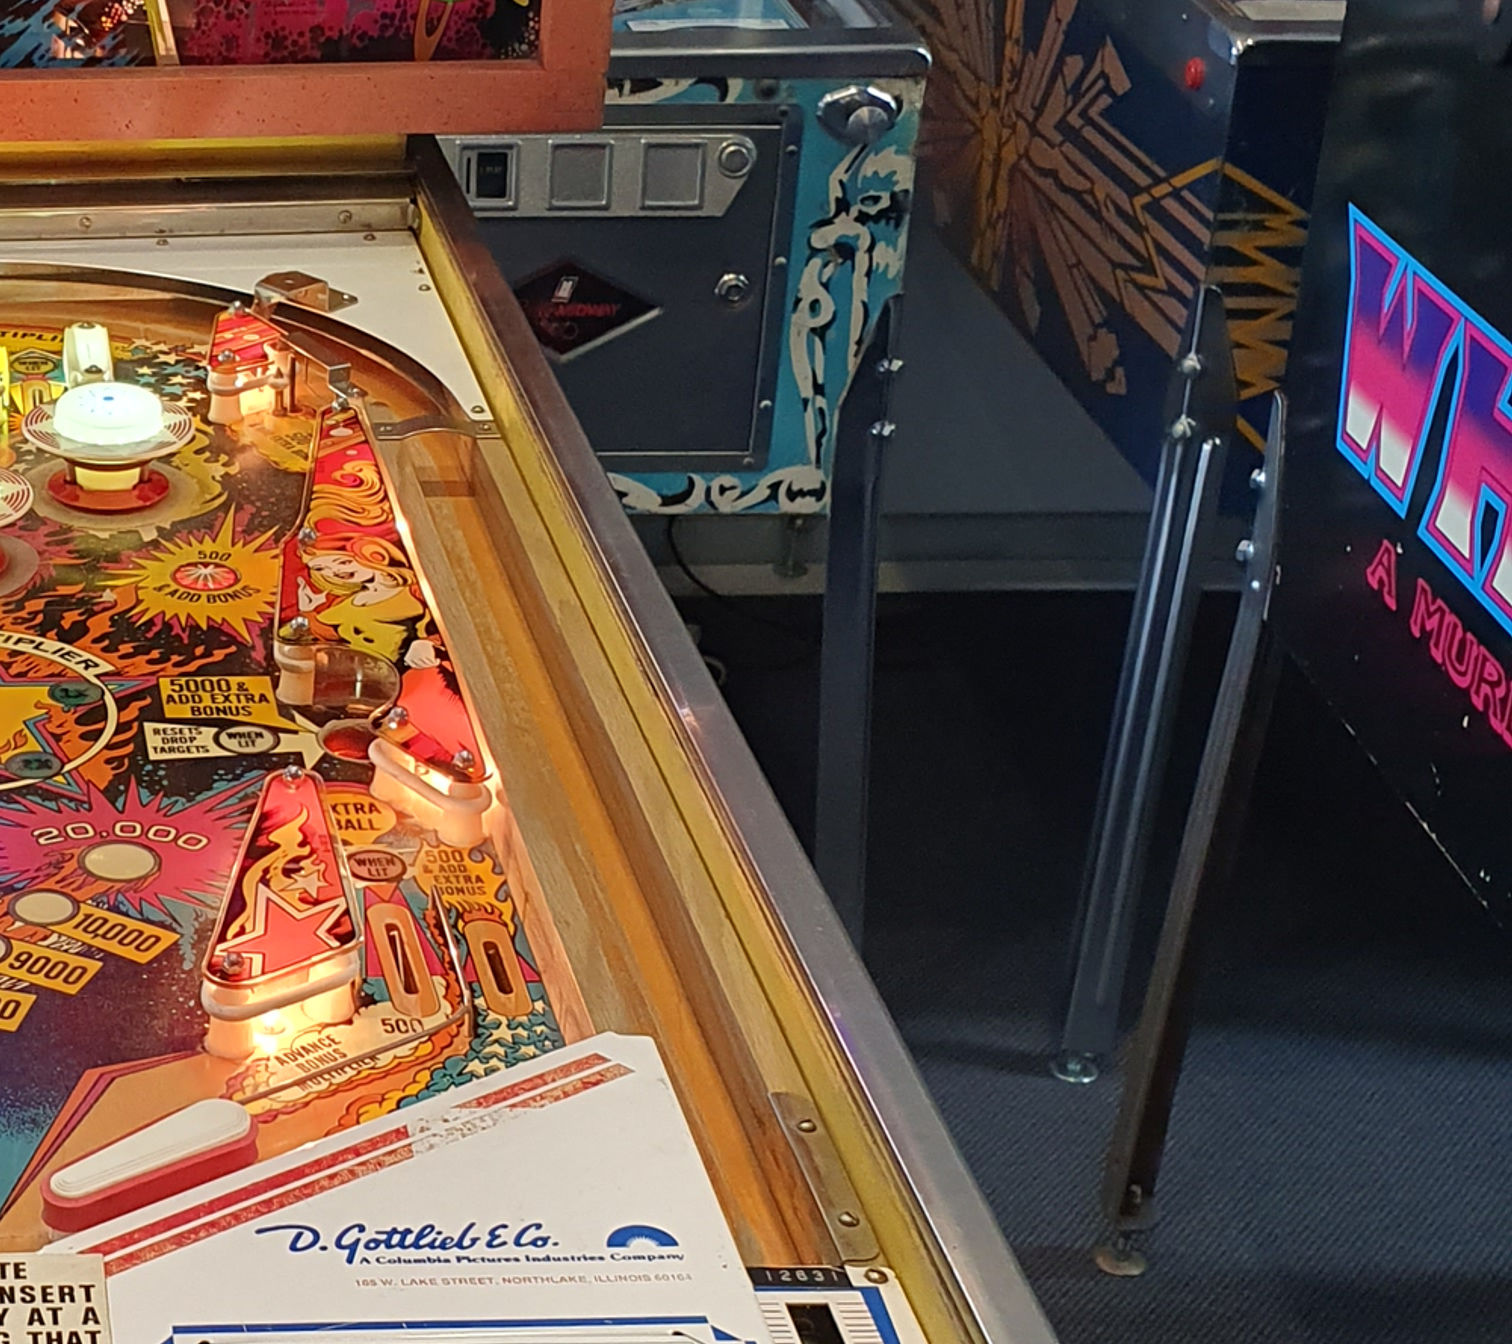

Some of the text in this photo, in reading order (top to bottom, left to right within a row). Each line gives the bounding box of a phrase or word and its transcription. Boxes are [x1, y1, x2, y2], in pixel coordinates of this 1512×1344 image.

[198, 550, 232, 562] 500
[1366, 539, 1396, 611] A
[170, 678, 249, 693] 5000 &
[165, 693, 271, 705] ADD EXTRA
[190, 705, 253, 717] BONUS
[152, 726, 203, 736] RESETS
[225, 730, 265, 740] WHEN
[161, 736, 197, 745] DROP
[238, 739, 258, 748] LIT
[151, 745, 210, 755] TARGETS
[353, 857, 396, 867] WHEN
[425, 849, 465, 863] 500
[368, 868, 389, 877] LIT
[433, 875, 485, 885] EXTRA
[71, 912, 163, 954] 10,000
[7, 950, 89, 987] 9000
[275, 1034, 342, 1066] ADVANCE
[297, 1048, 347, 1073] BONUS
[335, 1222, 480, 1265] Gottlieb
[513, 1223, 559, 1250] Co.
[359, 1252, 684, 1265] A Columbia Pictures Industries Company
[26, 1307, 63, 1326] AT
[81, 1307, 101, 1325] A
